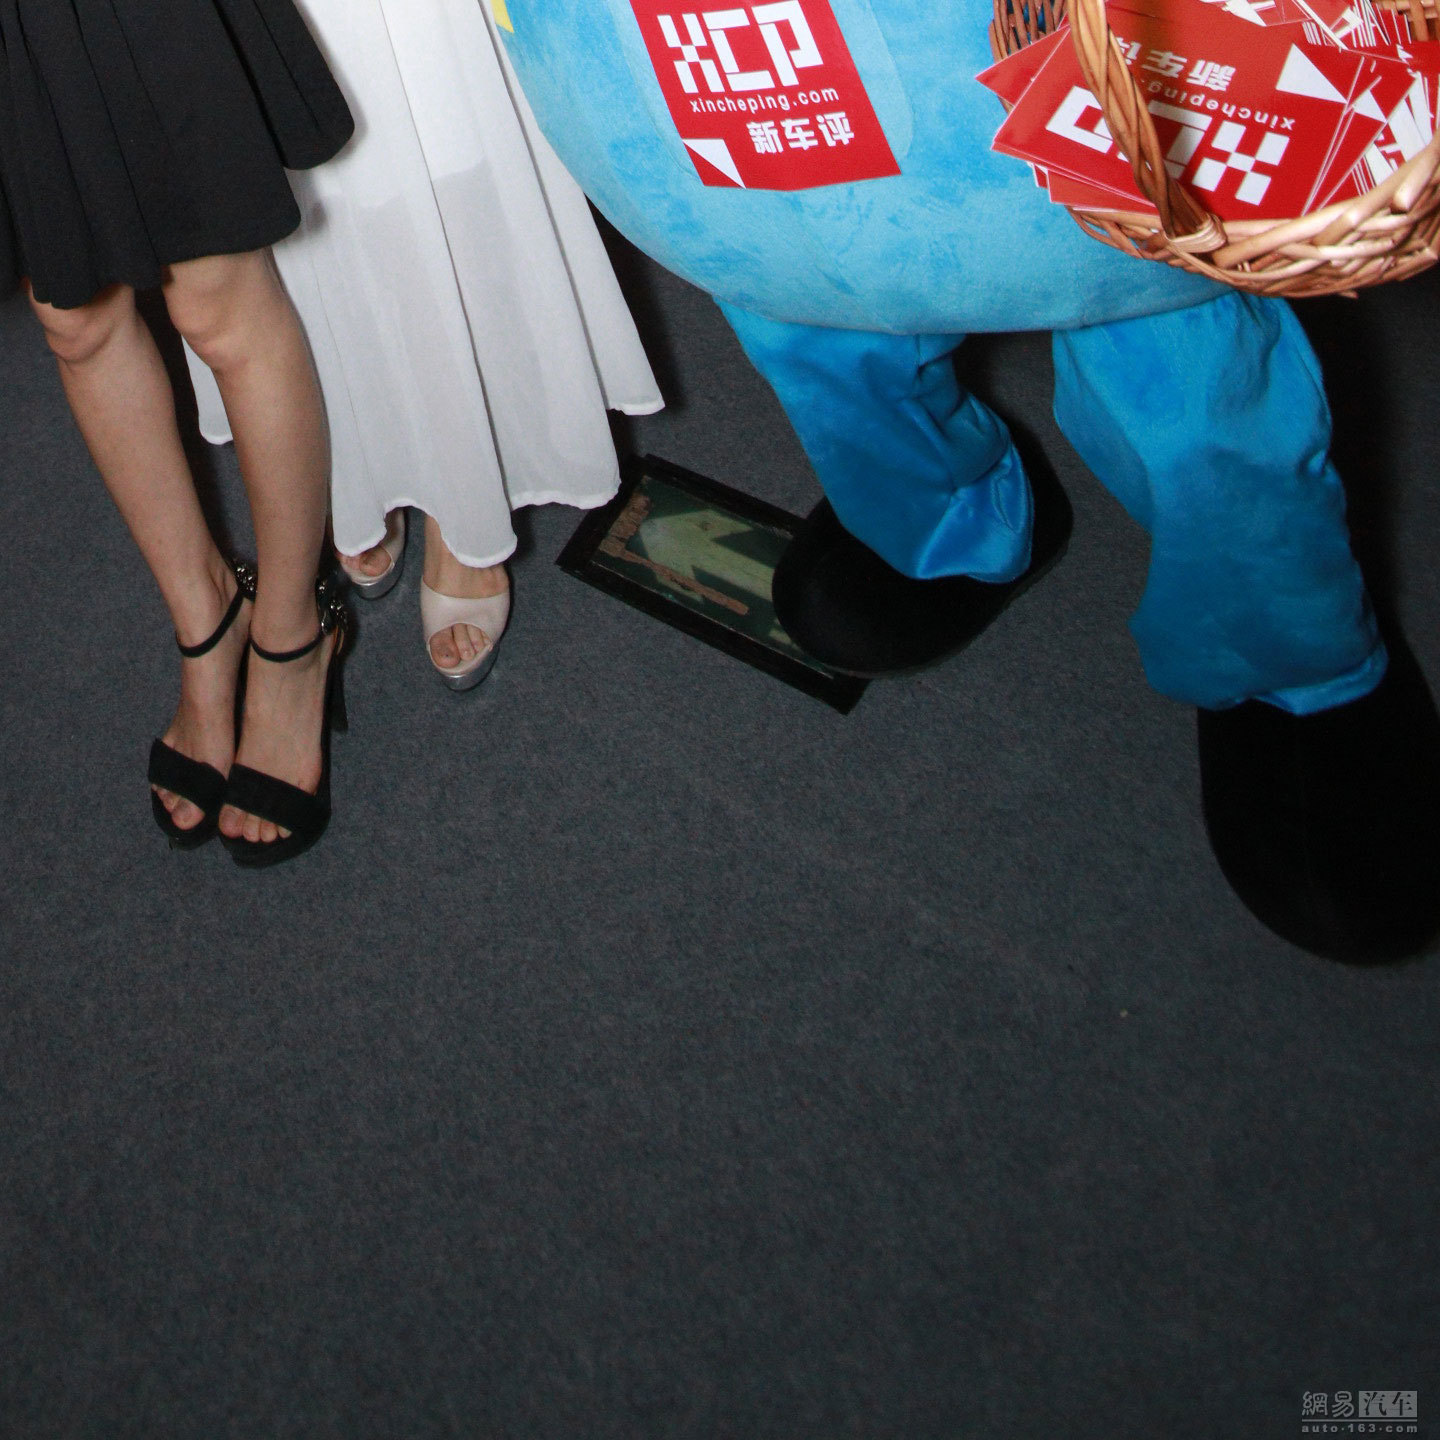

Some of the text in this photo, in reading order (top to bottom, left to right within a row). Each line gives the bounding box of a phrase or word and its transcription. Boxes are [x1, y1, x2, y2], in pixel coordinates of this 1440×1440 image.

[657, 0, 824, 94] XCP
[689, 87, 839, 114] xincheping.com
[746, 111, 854, 154] 新车评
